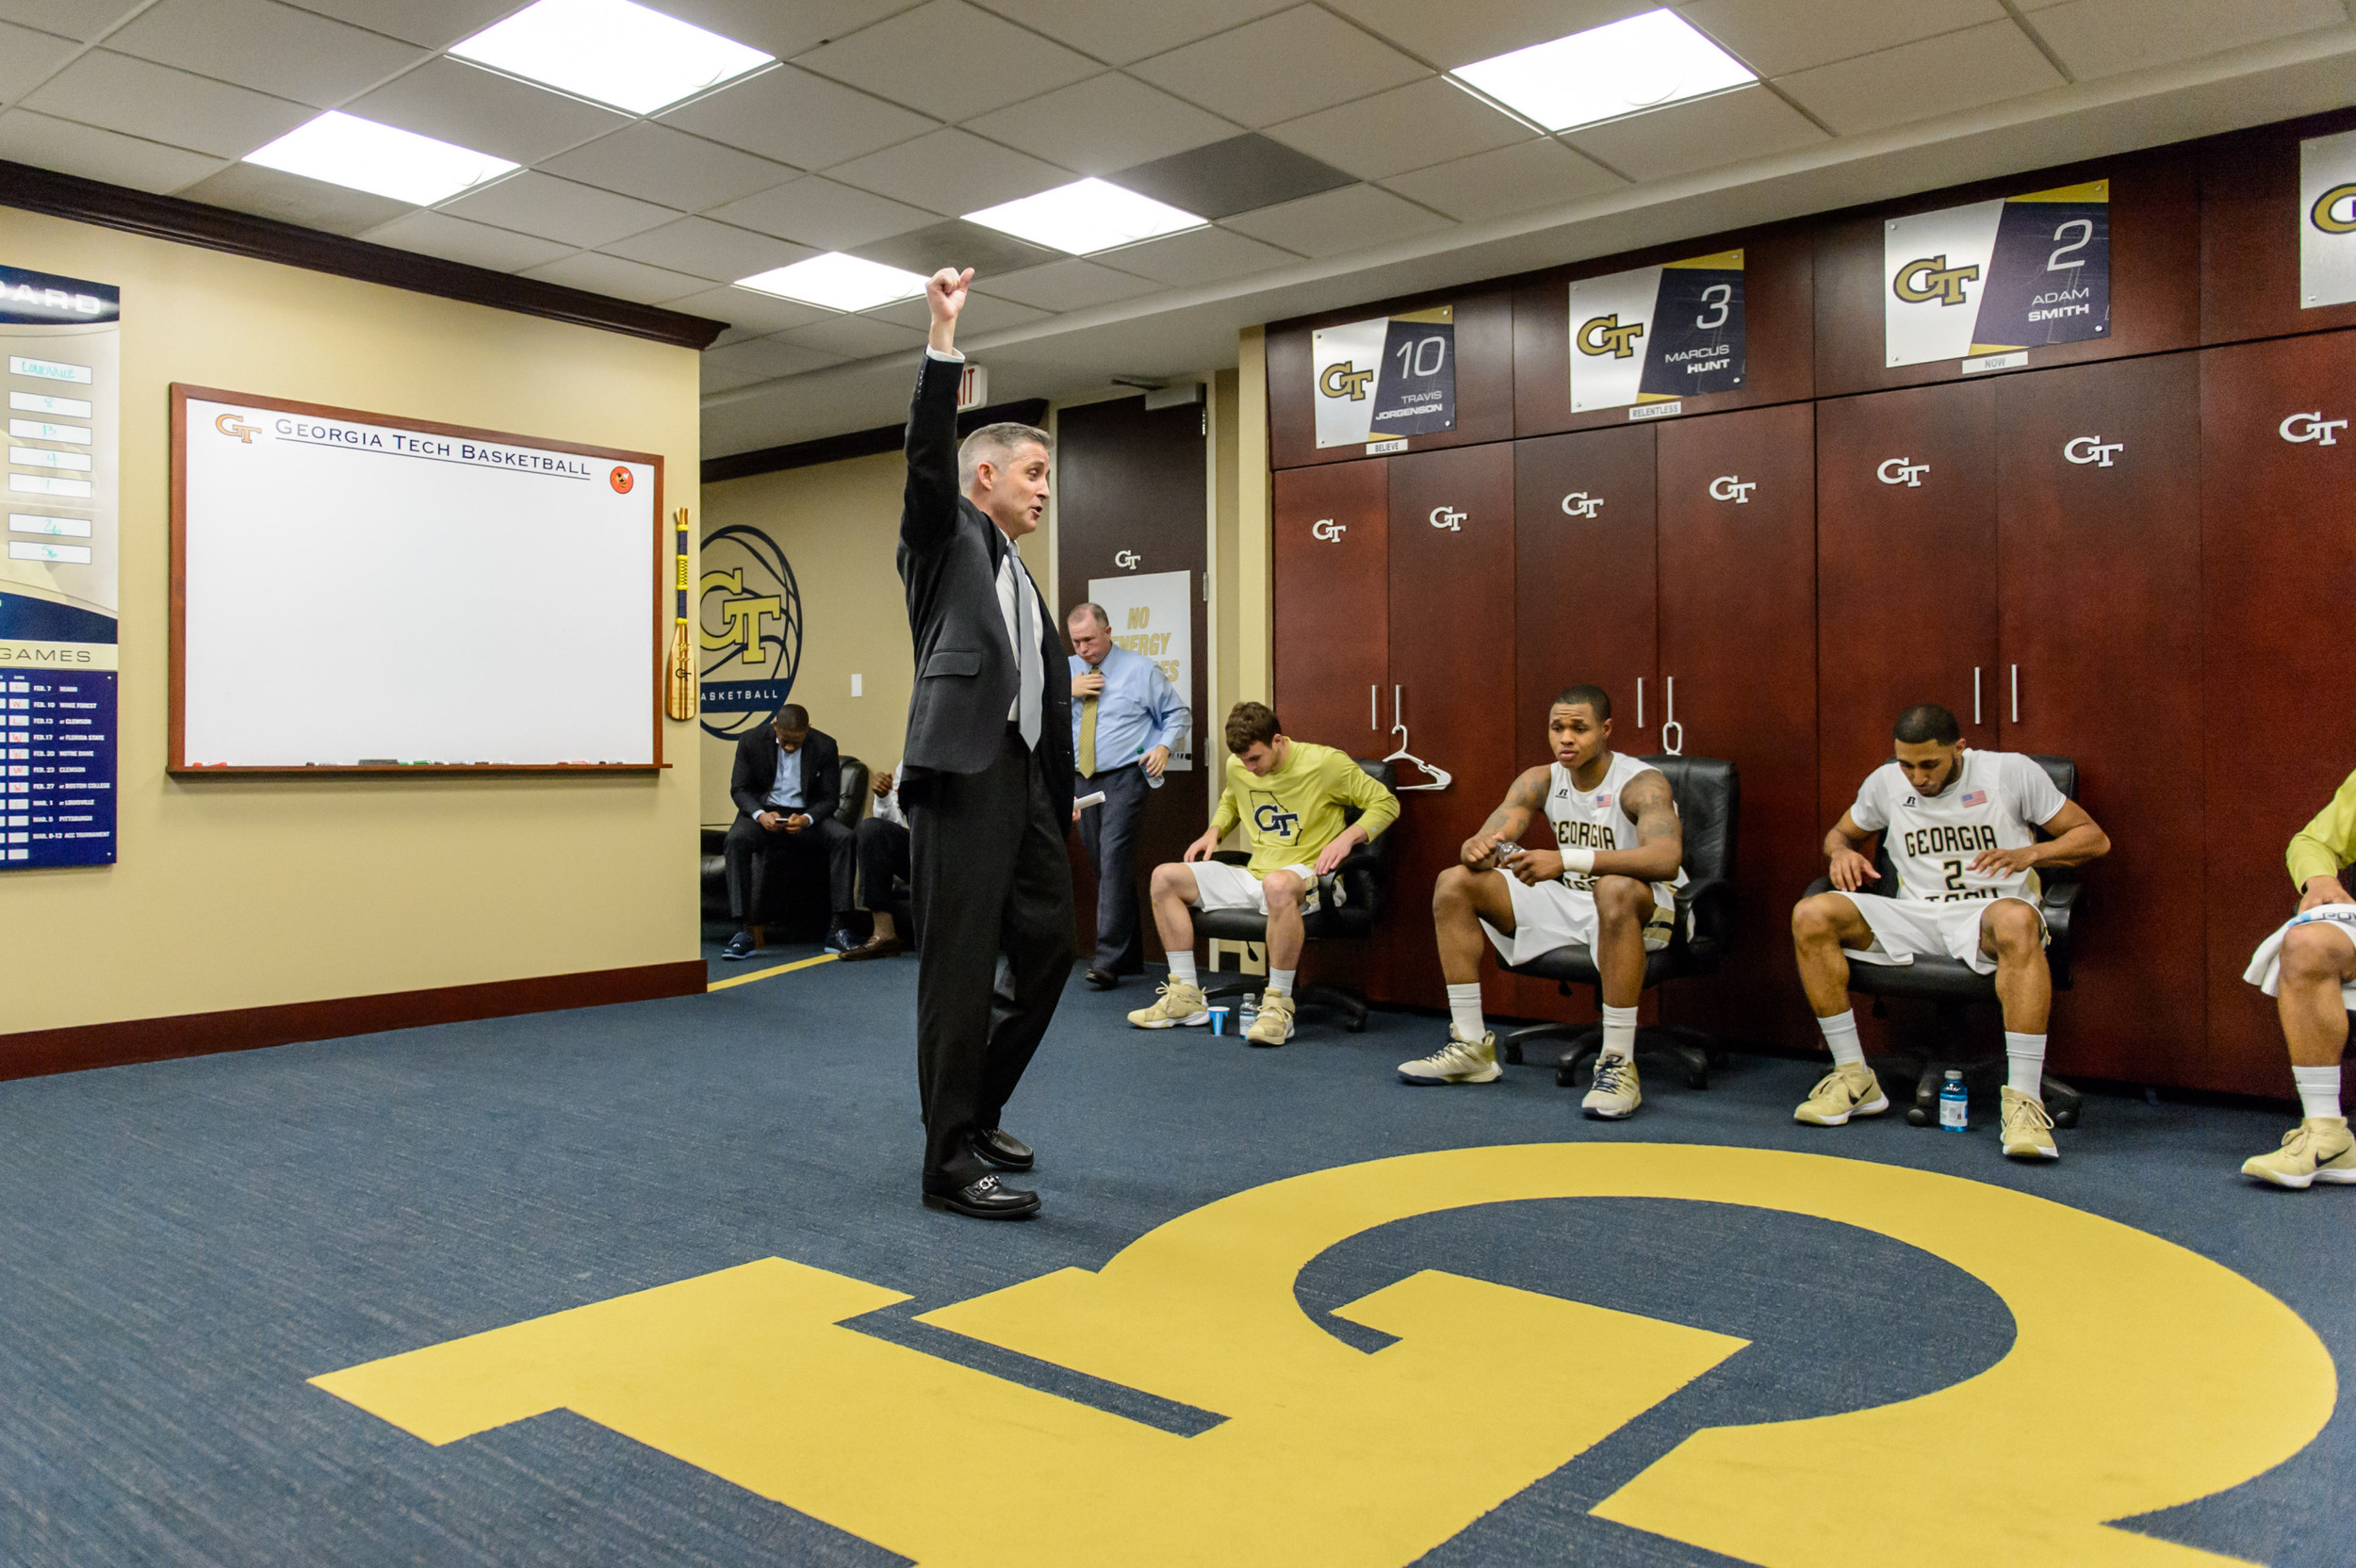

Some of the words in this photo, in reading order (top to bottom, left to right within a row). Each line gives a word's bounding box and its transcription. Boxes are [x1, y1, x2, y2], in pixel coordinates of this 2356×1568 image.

[2047, 219, 2093, 271] 2
[1893, 254, 1979, 307] GT
[0, 283, 101, 315] ARD
[1696, 284, 1732, 330] 3
[2032, 286, 2090, 306] ADAM
[2028, 303, 2090, 322] SMITH
[1577, 313, 1644, 360] GT
[1396, 335, 1446, 380] 10
[1664, 344, 1730, 364] MARCUS
[1687, 358, 1730, 374] HUNT
[1984, 357, 2006, 368] NOW
[957, 368, 975, 406] IT
[1319, 360, 1374, 402] GT
[1400, 390, 1443, 404] TRAVIS
[1632, 404, 1679, 417] RELENTLESS
[1375, 403, 1444, 420] JORGENSON
[2279, 412, 2348, 446] GT
[215, 413, 262, 444] GT
[275, 418, 383, 448] GEORGIA
[392, 434, 450, 457] TECH
[462, 444, 592, 476] BASKETBALL
[1375, 442, 1399, 453] BELIEVE
[2063, 435, 2124, 467] GT
[1876, 457, 1930, 487] GT
[1709, 475, 1757, 504] GT
[1429, 506, 1467, 531] GT
[1562, 492, 1604, 519] GT
[1312, 519, 1347, 543] GT
[1115, 549, 1141, 570] GT
[1127, 607, 1150, 630] NO
[0, 648, 90, 662] GAMES
[701, 690, 777, 701] ASKETBALL
[1253, 804, 1299, 837] GT
[1904, 825, 1998, 858] GEORGIA
[1942, 858, 1967, 891] 2
